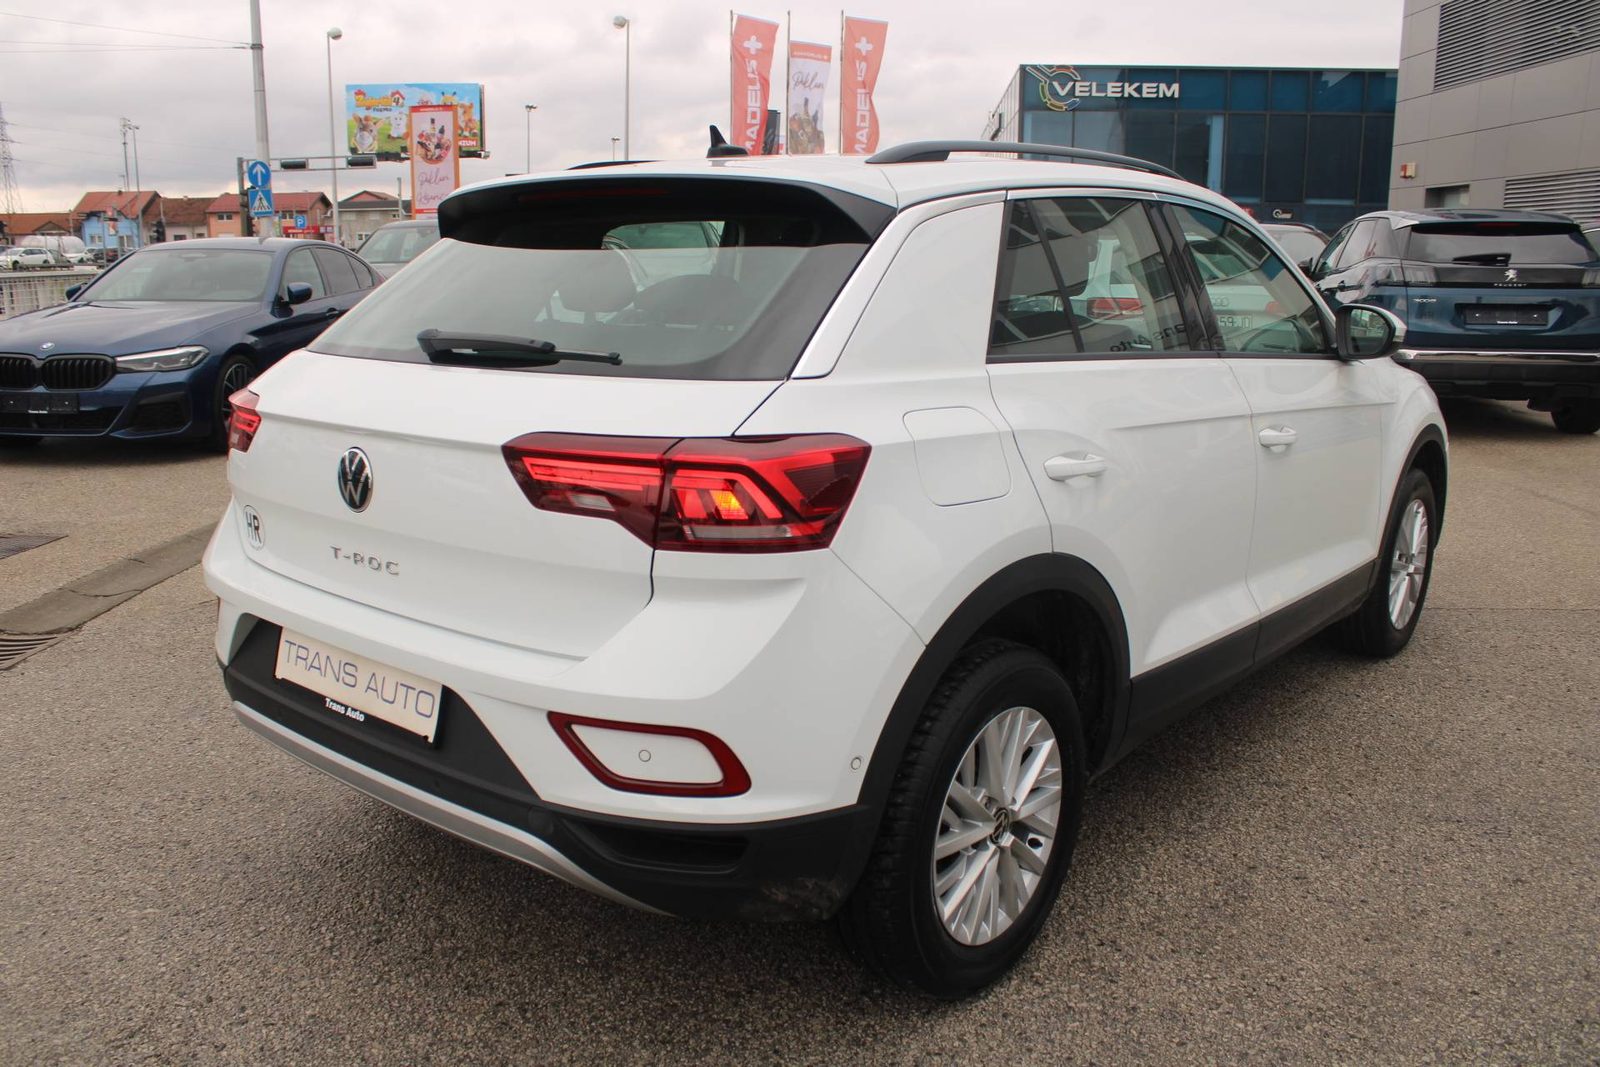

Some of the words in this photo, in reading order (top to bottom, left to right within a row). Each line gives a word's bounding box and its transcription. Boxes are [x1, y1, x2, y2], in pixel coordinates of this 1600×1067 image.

[1052, 81, 1180, 98] VELEKEM
[245, 512, 262, 543] HR
[329, 546, 400, 576] T-ROC
[284, 639, 358, 689] TRANS
[364, 672, 436, 719] AUTO
[325, 697, 345, 715] Trans
[346, 705, 365, 722] Auto
